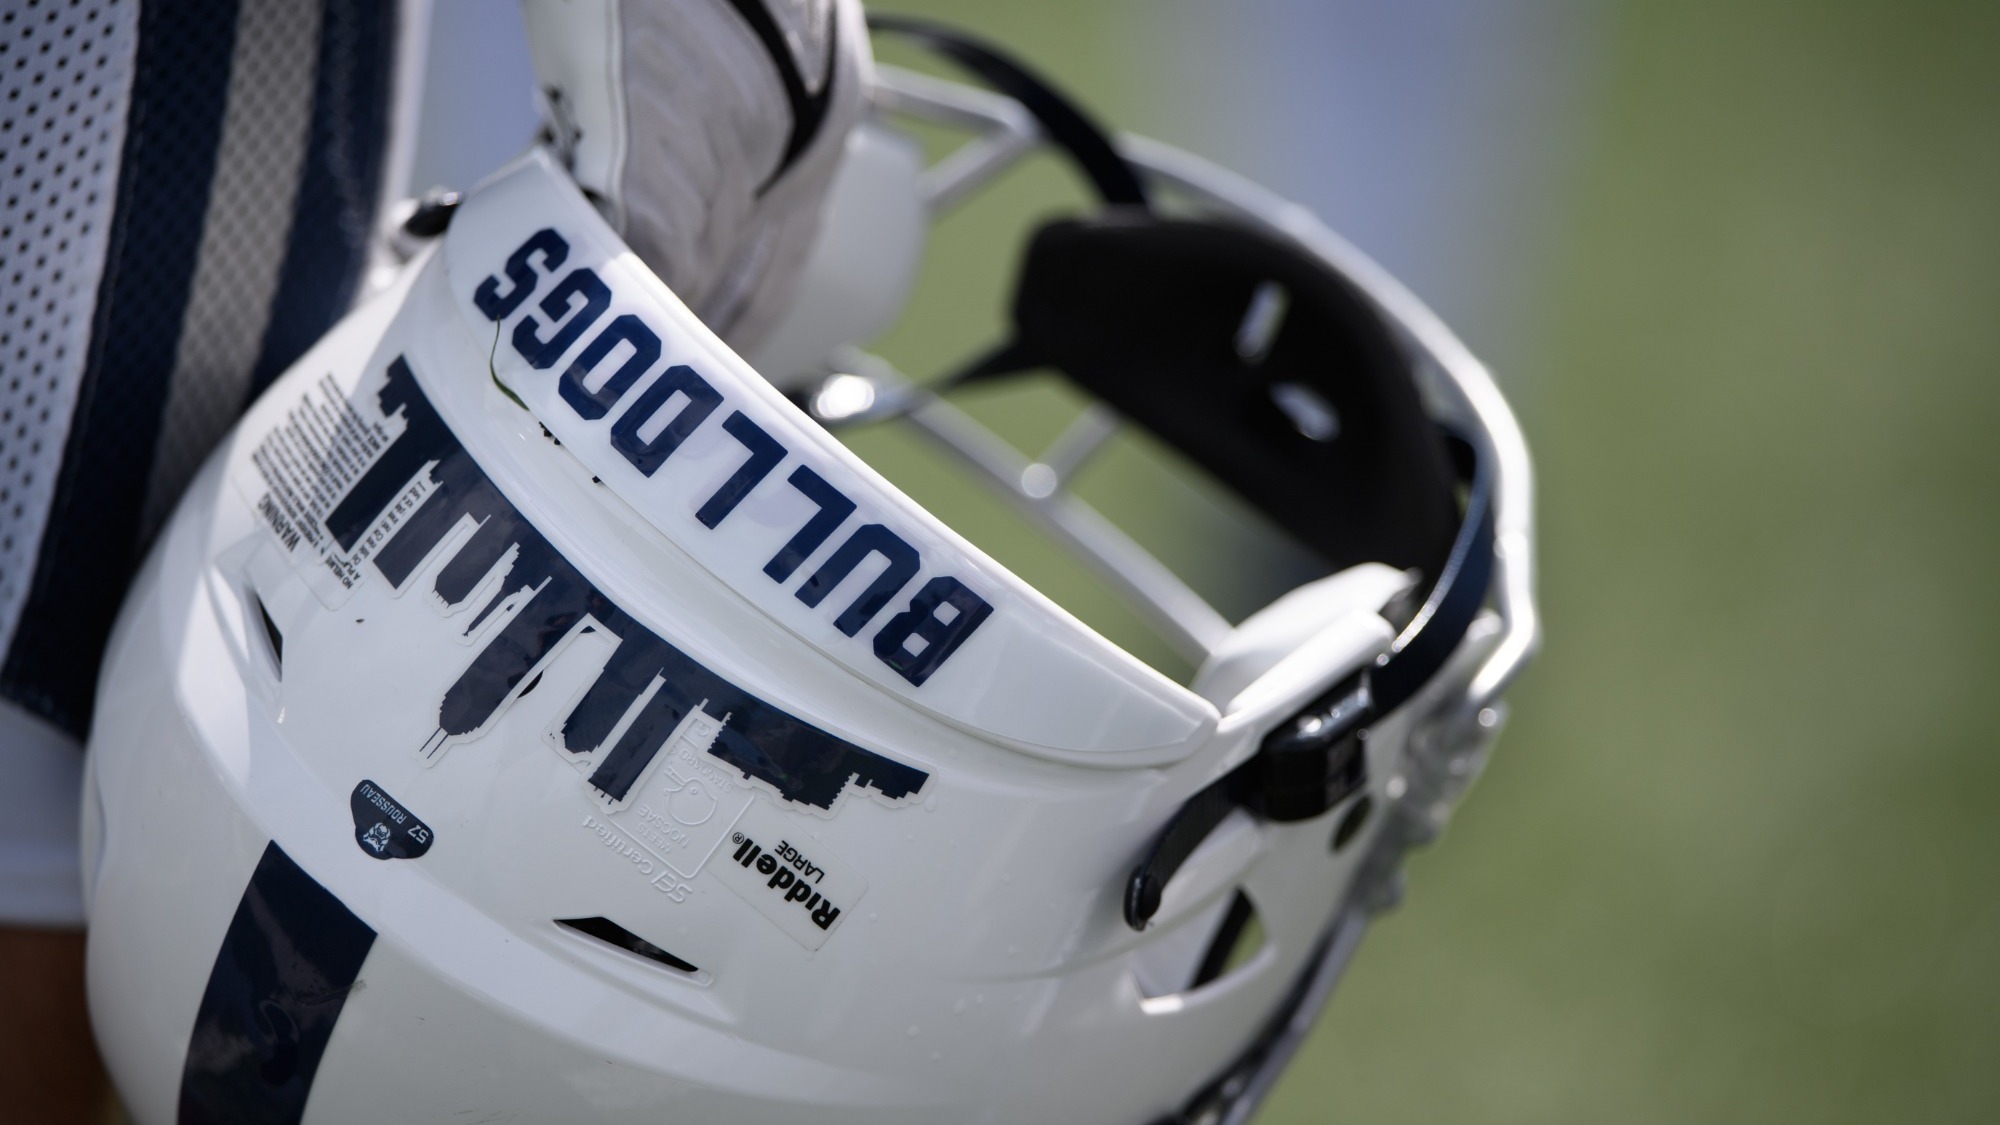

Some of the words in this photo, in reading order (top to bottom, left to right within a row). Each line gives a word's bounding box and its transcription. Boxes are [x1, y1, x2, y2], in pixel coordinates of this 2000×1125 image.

[473, 228, 994, 687] BULLDOGS
[258, 492, 301, 553] WARNING
[342, 577, 353, 590] NO
[360, 784, 407, 824] ROUSSEAU
[407, 824, 429, 844] 57
[582, 814, 653, 876] Certified
[637, 803, 690, 849] NOCSAE
[637, 821, 671, 854] MEETS
[774, 839, 825, 884] LARGE
[651, 870, 692, 903] SEI
